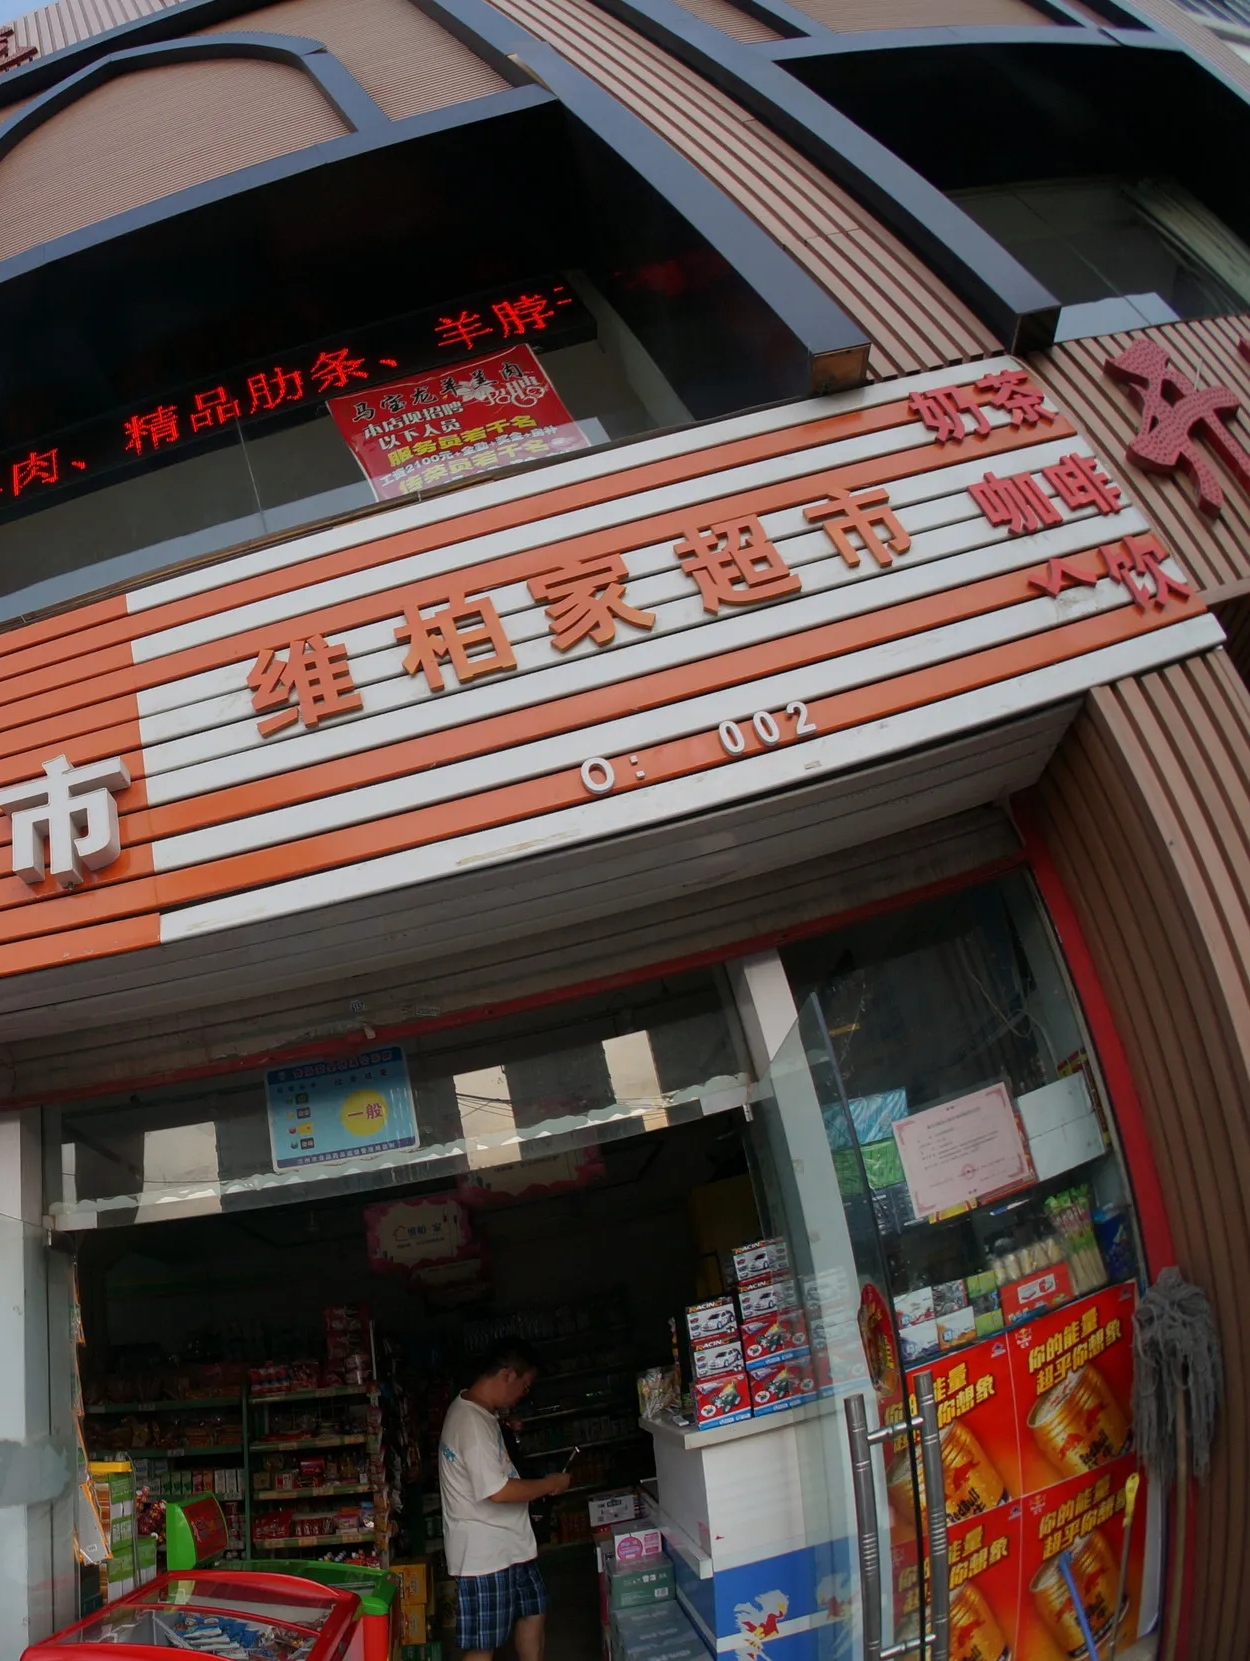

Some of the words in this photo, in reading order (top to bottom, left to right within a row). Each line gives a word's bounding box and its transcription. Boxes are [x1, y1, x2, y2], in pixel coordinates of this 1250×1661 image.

[364, 401, 464, 440] 本店现招聘
[379, 419, 462, 450] 以下人员
[908, 369, 1057, 447] 奶茶
[387, 415, 538, 469] 服务员若干名
[967, 451, 1123, 536] 咖啡
[246, 486, 912, 738] 维柏家超市
[718, 701, 818, 758] 002
[348, 1102, 383, 1120] 一般
[1028, 1306, 1099, 1375] 你的能量
[1036, 1318, 1122, 1397] 超乎你想象
[1038, 1474, 1112, 1540] 你的能量
